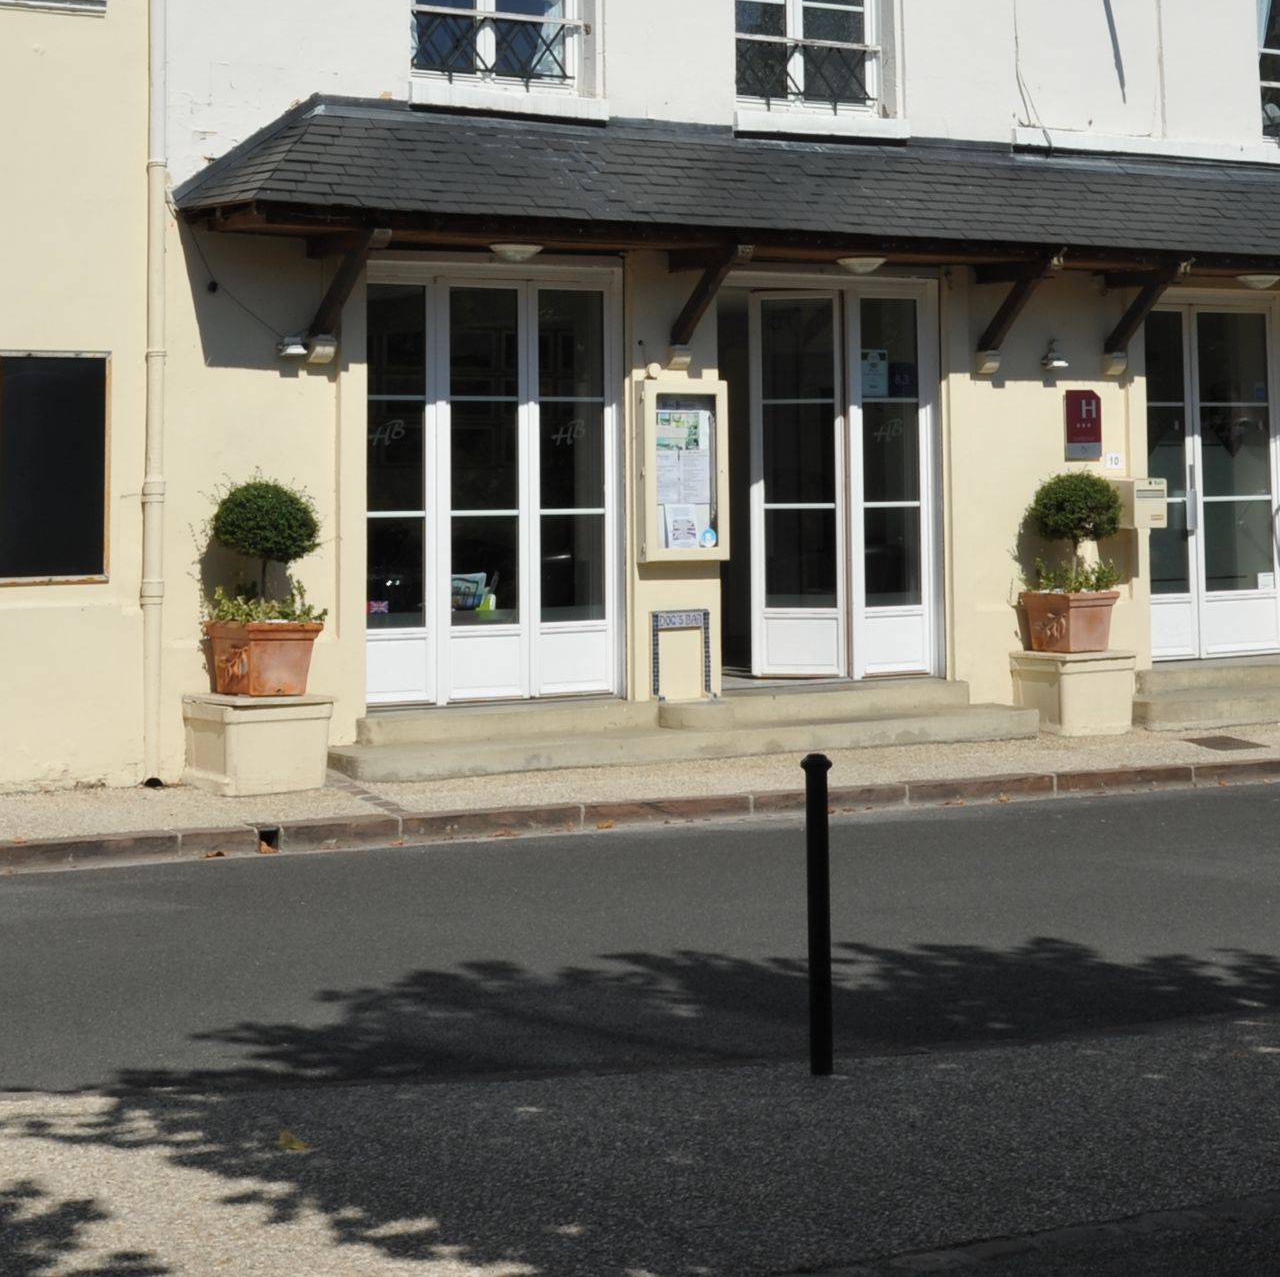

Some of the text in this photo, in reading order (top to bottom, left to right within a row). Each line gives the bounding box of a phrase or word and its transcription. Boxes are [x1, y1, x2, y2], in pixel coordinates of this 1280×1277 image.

[1081, 399, 1097, 419] H
[1109, 456, 1120, 467] 10
[685, 612, 703, 626] BAR
